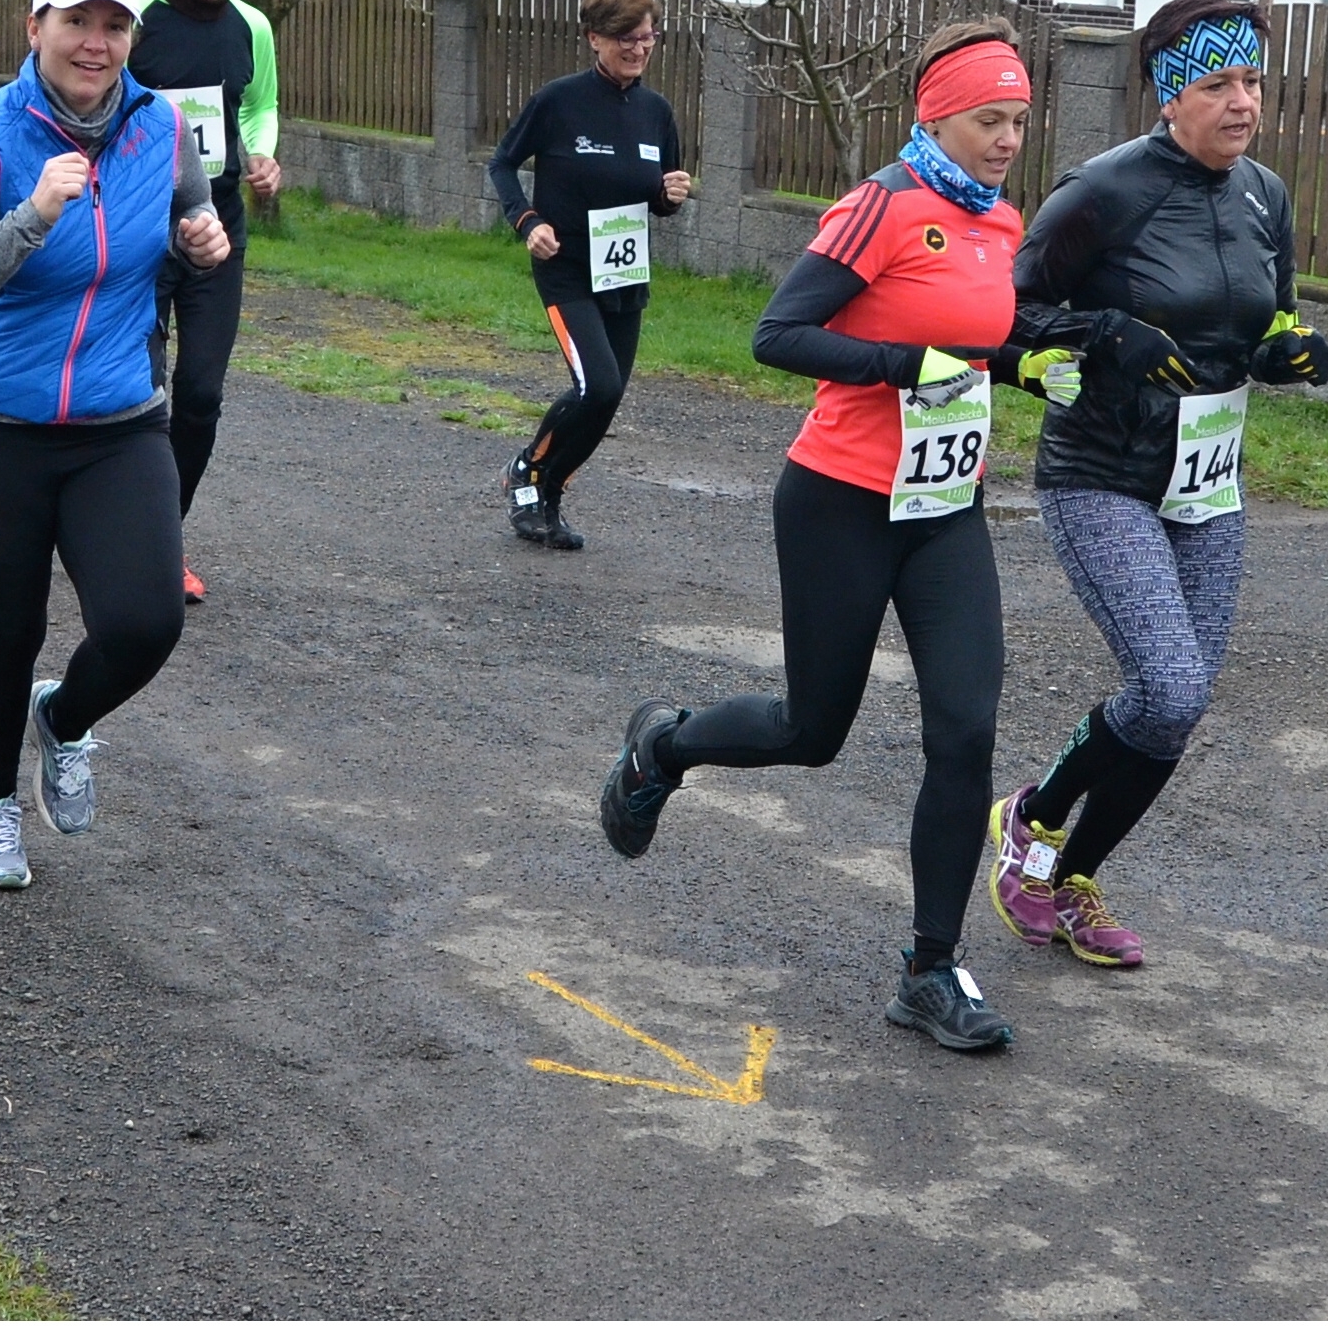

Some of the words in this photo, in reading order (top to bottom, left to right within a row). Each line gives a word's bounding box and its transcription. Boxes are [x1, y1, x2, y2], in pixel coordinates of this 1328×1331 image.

[603, 237, 637, 268] 48
[904, 430, 982, 484] 138
[1178, 437, 1235, 494] 144
